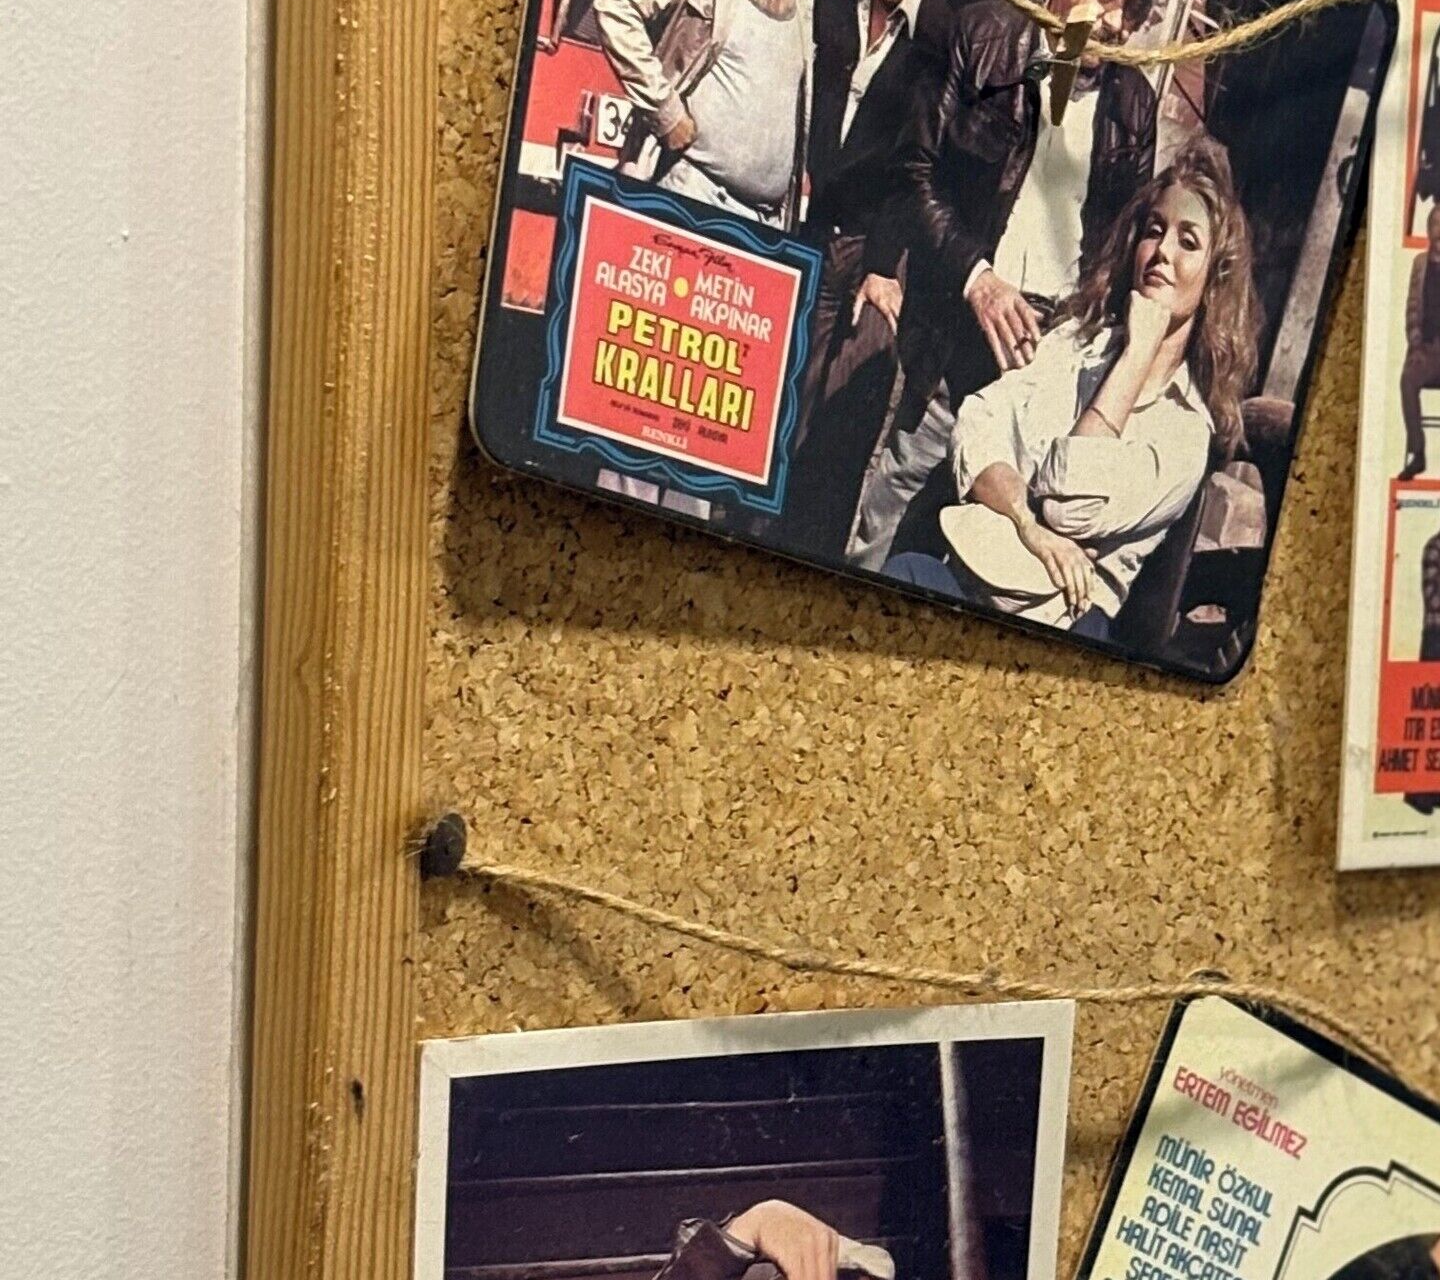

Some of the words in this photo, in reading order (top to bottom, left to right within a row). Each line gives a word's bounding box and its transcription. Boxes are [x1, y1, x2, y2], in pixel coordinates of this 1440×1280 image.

[595, 261, 667, 306] ALASYA
[628, 245, 673, 281] ZEKİ
[694, 272, 755, 308] METİN
[607, 299, 742, 376] PETROL
[690, 295, 773, 343] AKPINAR
[592, 338, 756, 432] KRALLARI
[1173, 1066, 1232, 1117] ERTEM
[1155, 1134, 1215, 1184] MÜNİR
[1218, 1164, 1274, 1218] ÖZKUL
[1140, 1195, 1195, 1241] ADİLE
[1147, 1163, 1204, 1214] KEMAL
[1207, 1196, 1262, 1246] SUNAL
[1116, 1215, 1167, 1260] HALİT
